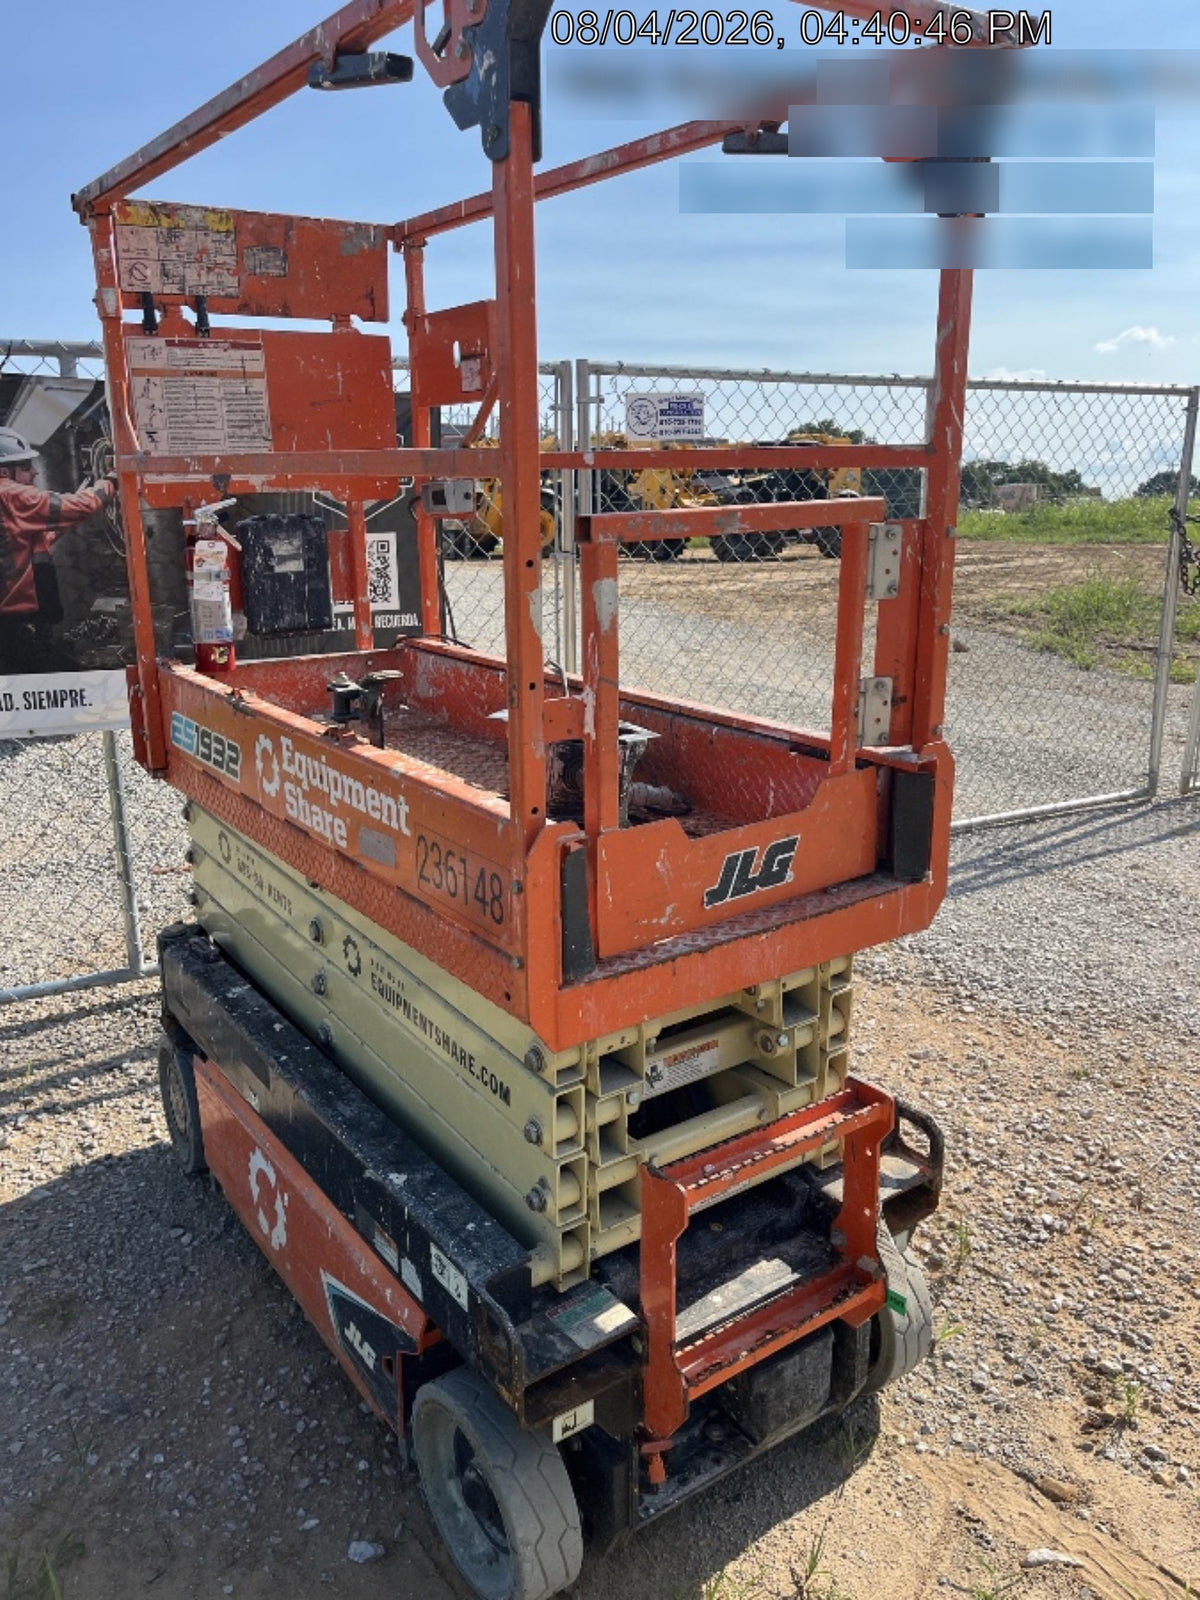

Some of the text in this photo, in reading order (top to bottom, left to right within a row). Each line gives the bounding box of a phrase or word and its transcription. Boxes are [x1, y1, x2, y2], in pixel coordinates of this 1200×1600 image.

[374, 613, 422, 629] RECUERDA.
[22, 688, 93, 711] SIEMPRE.
[280, 735, 411, 837] Equipment
[283, 780, 348, 849] Share
[416, 834, 504, 925] 236148
[704, 834, 801, 909] JLG
[370, 971, 512, 1108] EQUIPMENTSHARE.COM
